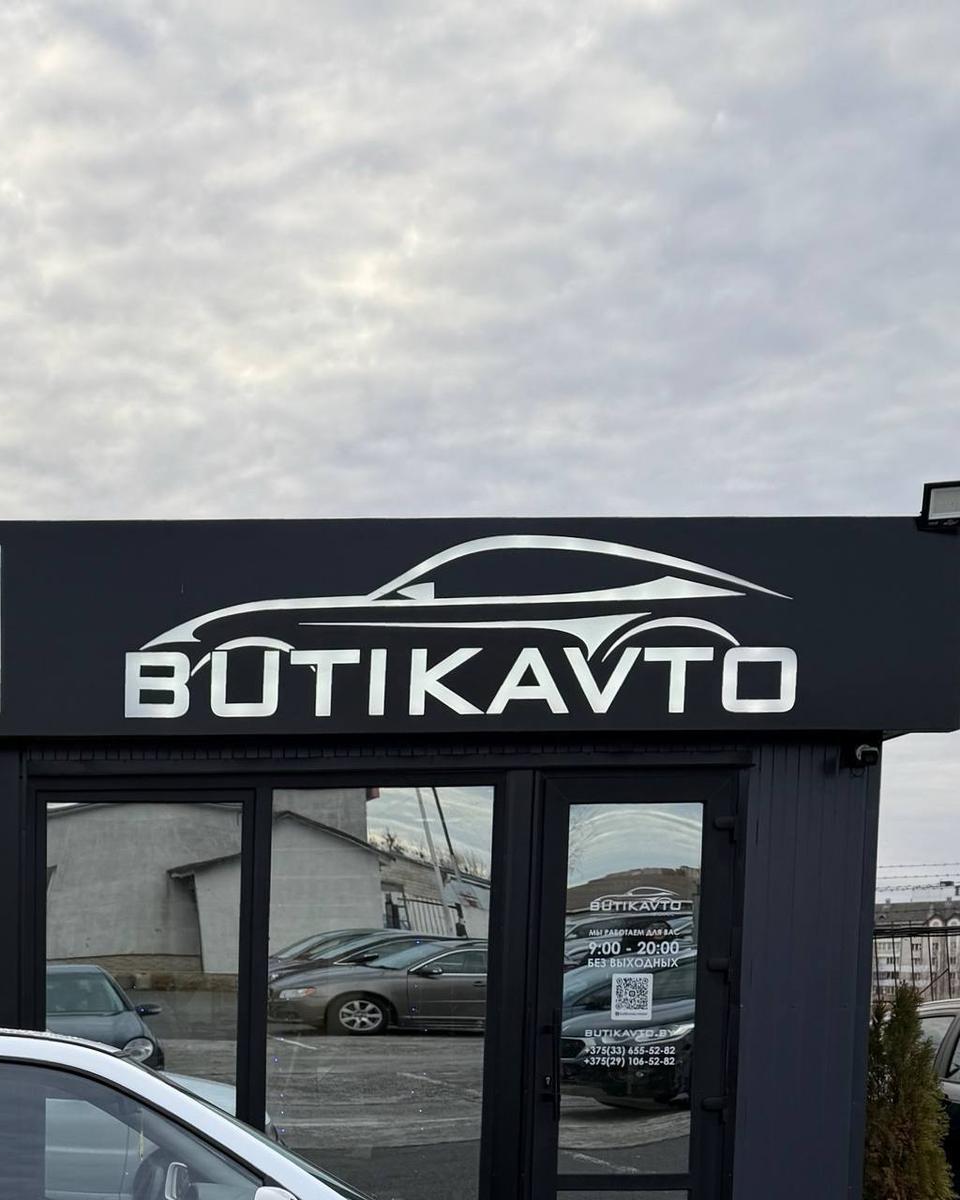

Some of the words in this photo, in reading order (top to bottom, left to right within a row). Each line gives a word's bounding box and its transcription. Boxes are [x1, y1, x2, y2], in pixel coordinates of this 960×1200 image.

[124, 646, 798, 719] BUTIKAVTO
[589, 901, 681, 912] BUTIKAVTO
[588, 941, 621, 955] 9:00
[637, 941, 680, 955] 20:00
[588, 958, 607, 968] БЕЗ
[609, 958, 679, 968] ВЫХОДНЫХ
[584, 1029, 676, 1037] BUTIKAVTO.BY
[584, 1046, 626, 1056] +375(33)
[627, 1046, 676, 1055] 655-52-82
[583, 1057, 626, 1067] +375(29)
[628, 1057, 676, 1066] 106-52-82
